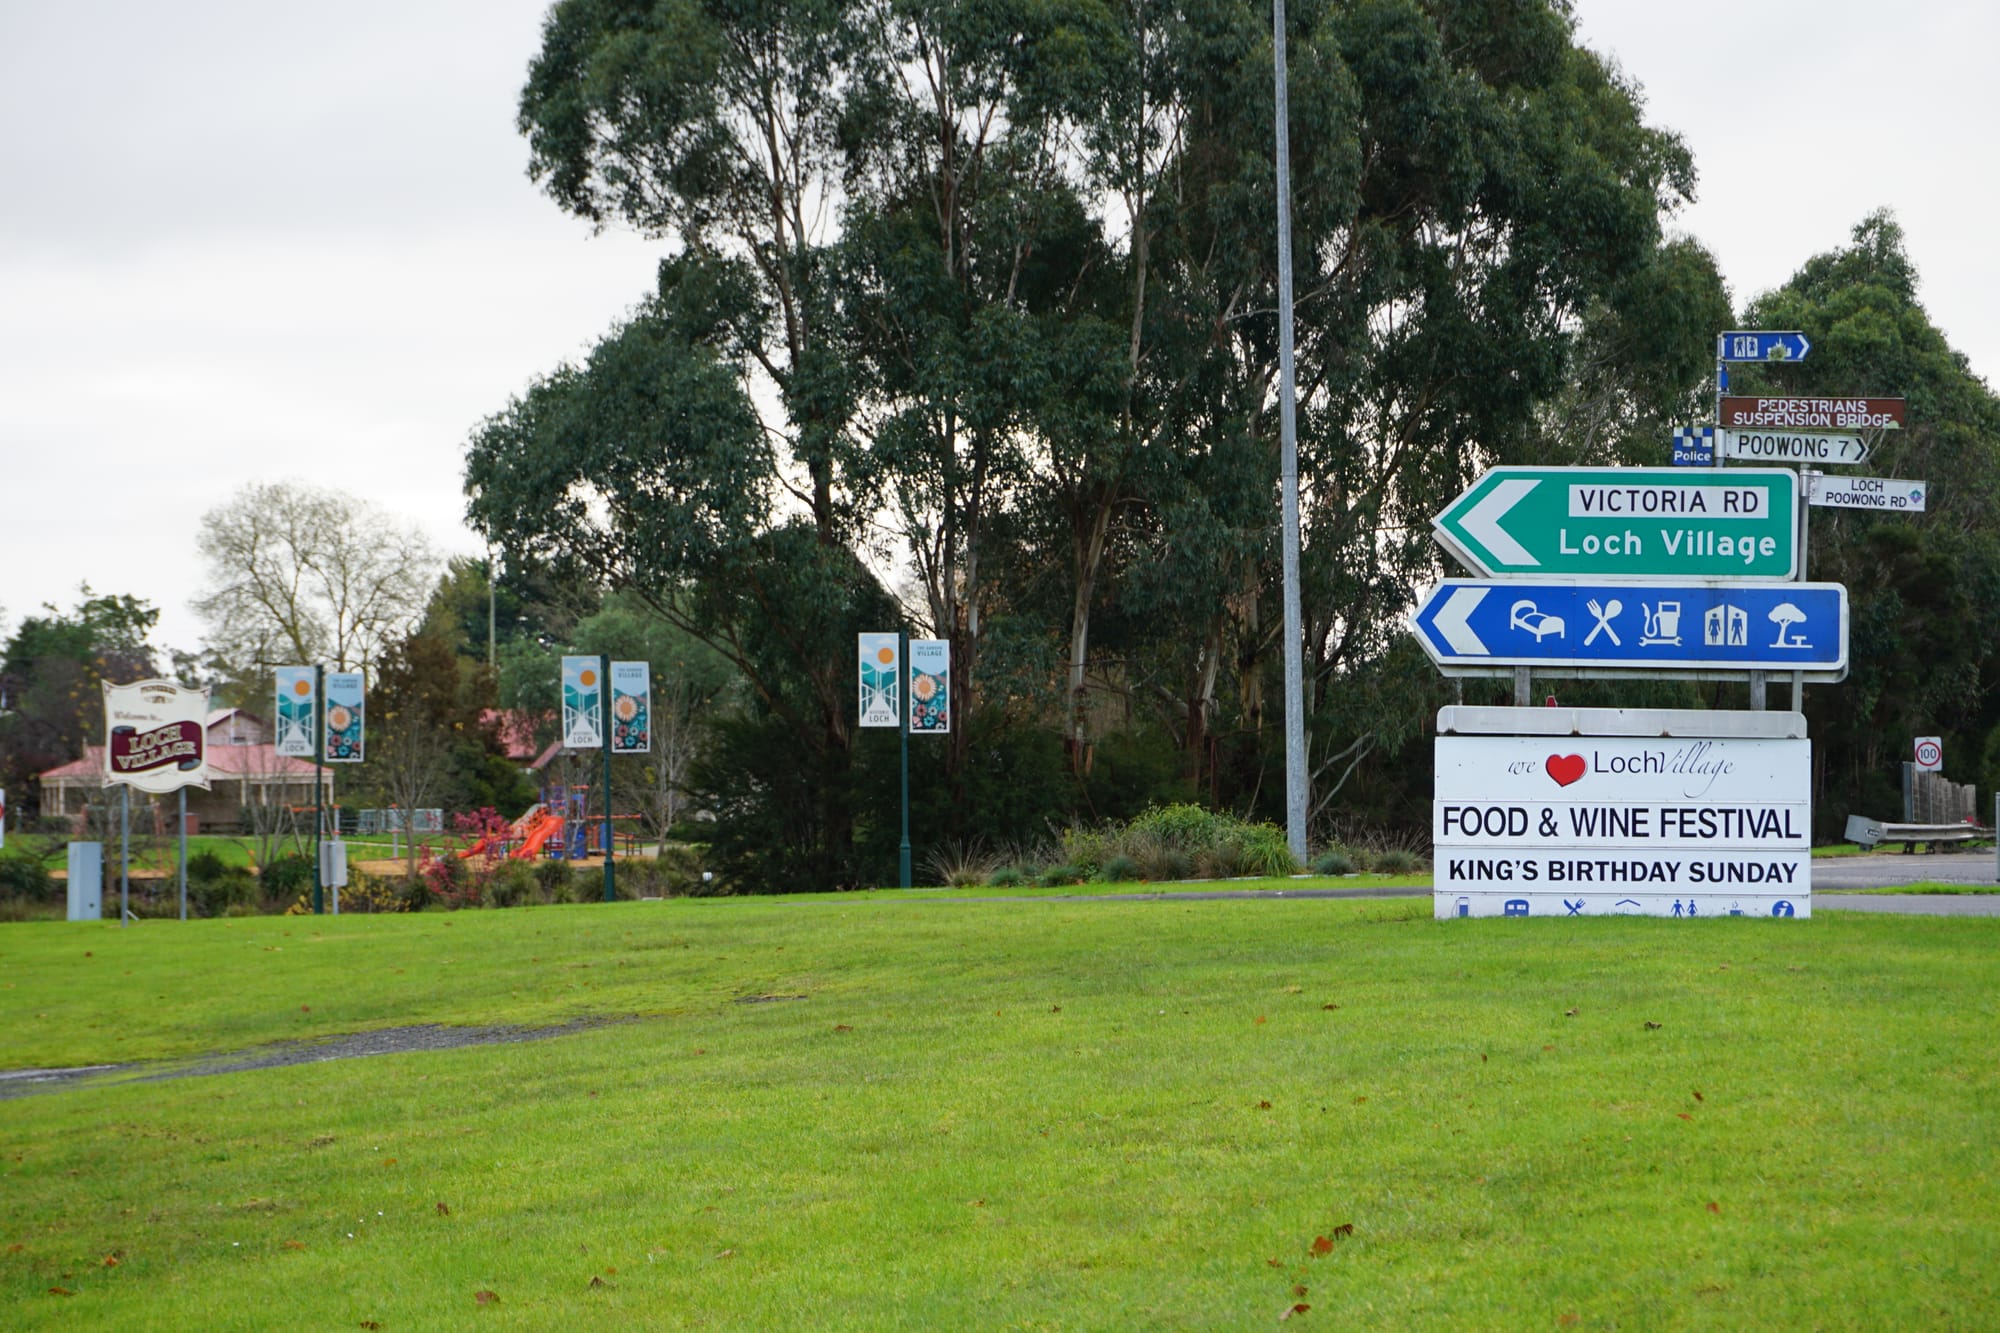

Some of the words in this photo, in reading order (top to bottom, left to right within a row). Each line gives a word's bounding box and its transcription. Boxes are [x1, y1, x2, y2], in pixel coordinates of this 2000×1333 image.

[1758, 400, 1867, 412] PEDESTRIANS
[1733, 412, 1830, 426] SUSPENSION
[1836, 413, 1892, 426] BRIDGE
[1738, 435, 1828, 457] POOWONG
[1838, 441, 1849, 457] 7
[1674, 451, 1711, 461] Police
[1851, 480, 1884, 492] LOCH
[1580, 490, 1707, 512] VICTORIA
[1724, 491, 1758, 512] RD
[1826, 492, 1886, 506] POOWONG
[1891, 496, 1907, 507] RD
[1560, 529, 1642, 555] Loch
[1660, 529, 1776, 565] Village
[128, 724, 183, 753] LOCH
[116, 741, 197, 769] VILLAGE
[1920, 749, 1937, 759] 100
[1507, 760, 1537, 775] we
[1443, 806, 1528, 837] FOOD
[1538, 808, 1559, 837] &
[1570, 807, 1649, 838] WINE
[1660, 808, 1802, 839] FESTIVAL
[1449, 860, 1538, 881] KING'S
[1548, 861, 1681, 882] BIRTHDAY
[1688, 862, 1798, 883] SUNDAY
